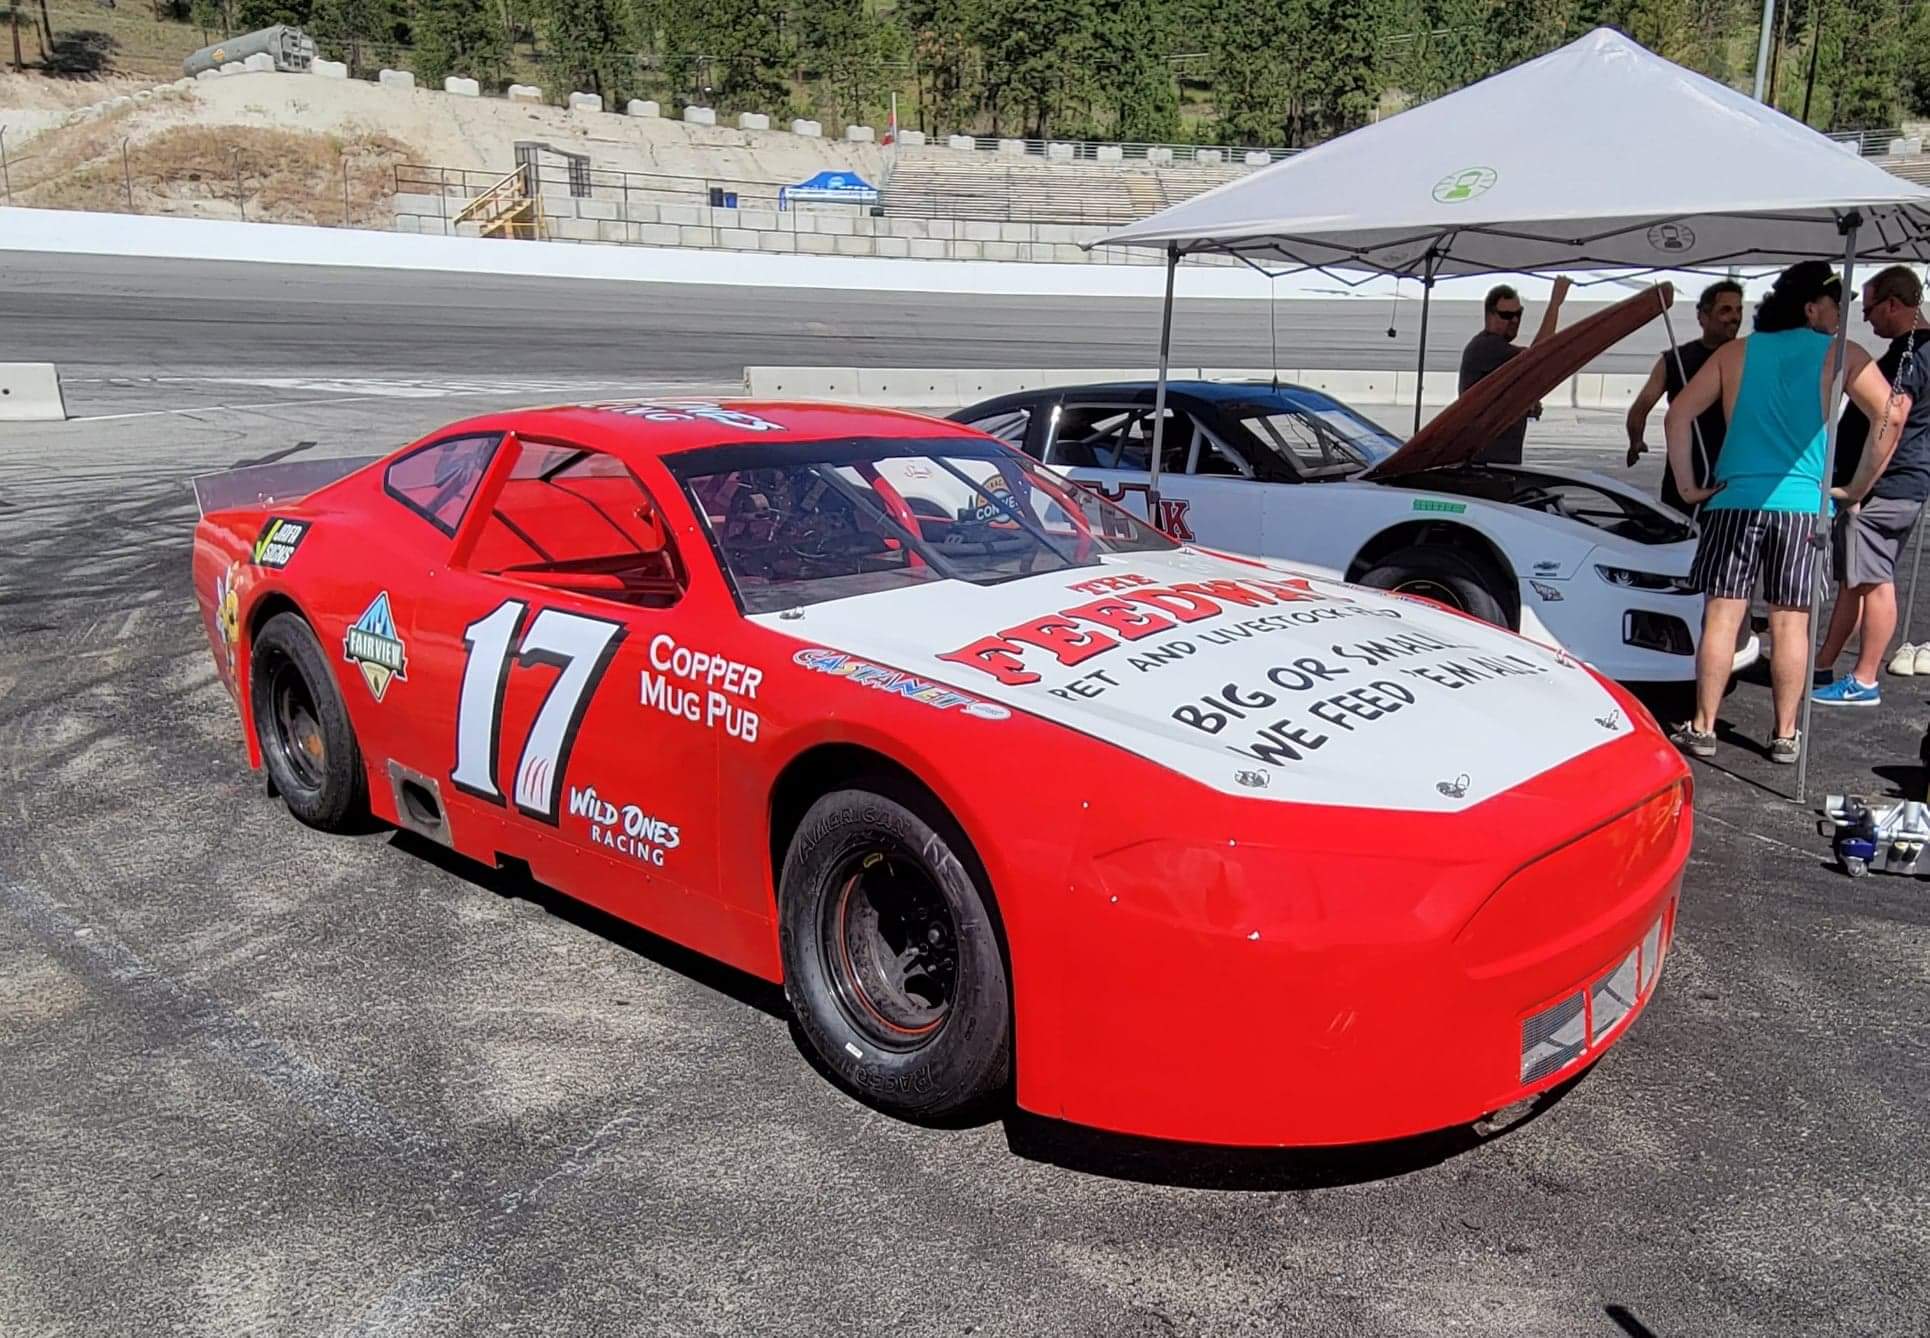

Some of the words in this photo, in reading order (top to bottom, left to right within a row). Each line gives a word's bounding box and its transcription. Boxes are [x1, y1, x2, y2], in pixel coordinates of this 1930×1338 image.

[1065, 573, 1161, 597] THE
[350, 630, 402, 668] FAIRVIEW
[649, 634, 763, 699] COPPER
[935, 578, 1350, 686] FEEDWAY
[1048, 669, 1120, 701] PET
[1128, 640, 1197, 673] AND
[1198, 607, 1344, 646] LIVESTOCK
[451, 599, 628, 826] 17
[640, 670, 702, 722] MUG
[706, 690, 760, 743] PUB
[1172, 683, 1277, 735] BIG
[1267, 656, 1350, 691] OR
[1332, 632, 1462, 666] SMALL
[1226, 719, 1329, 767] WE
[1308, 681, 1416, 731] FEED
[1400, 660, 1495, 689] 'EM
[591, 825, 665, 867] RACING
[622, 805, 680, 848] ONES
